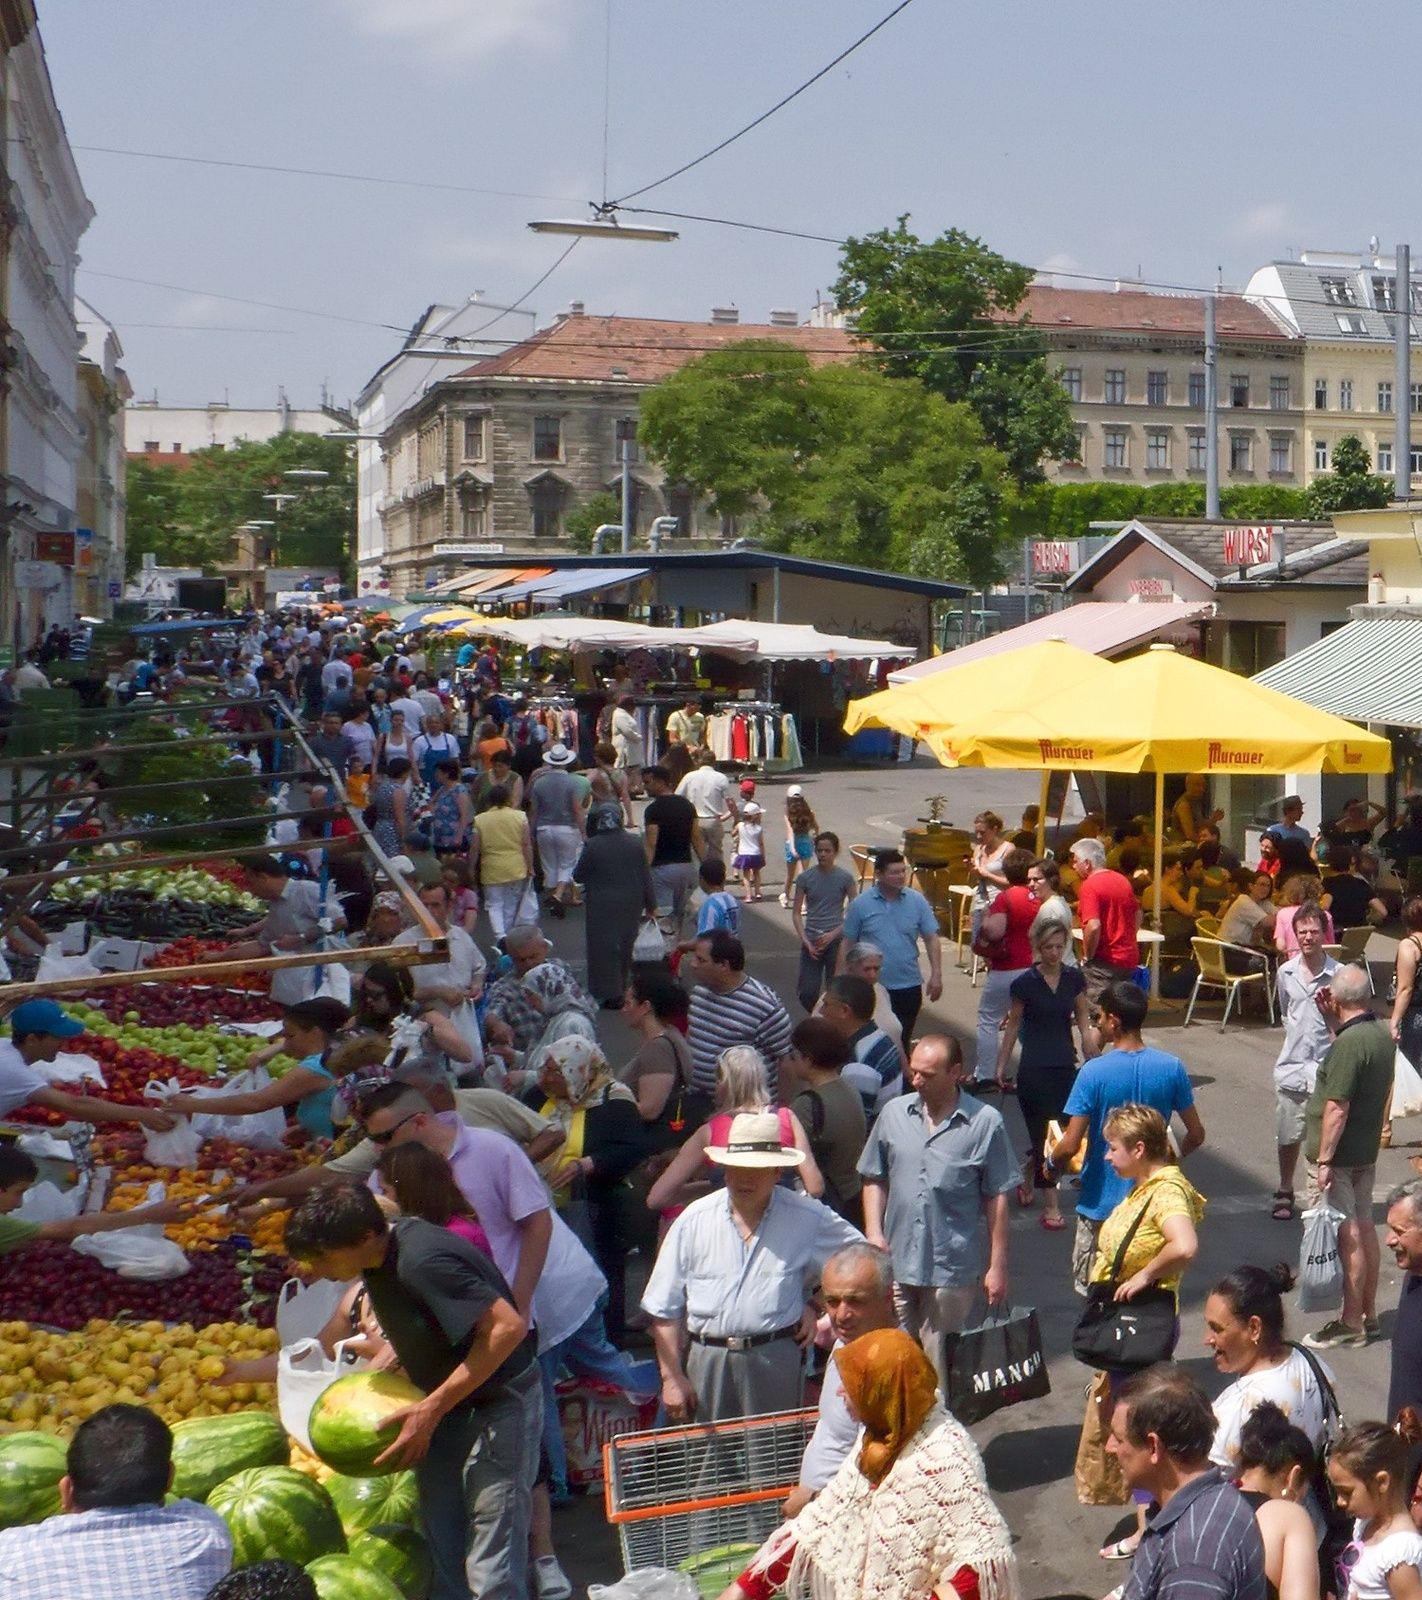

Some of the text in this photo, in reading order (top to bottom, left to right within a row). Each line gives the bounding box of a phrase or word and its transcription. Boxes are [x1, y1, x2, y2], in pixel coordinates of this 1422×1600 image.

[1223, 524, 1273, 565] WURST
[1038, 739, 1094, 764] Murauer
[1208, 742, 1264, 770] Murauer
